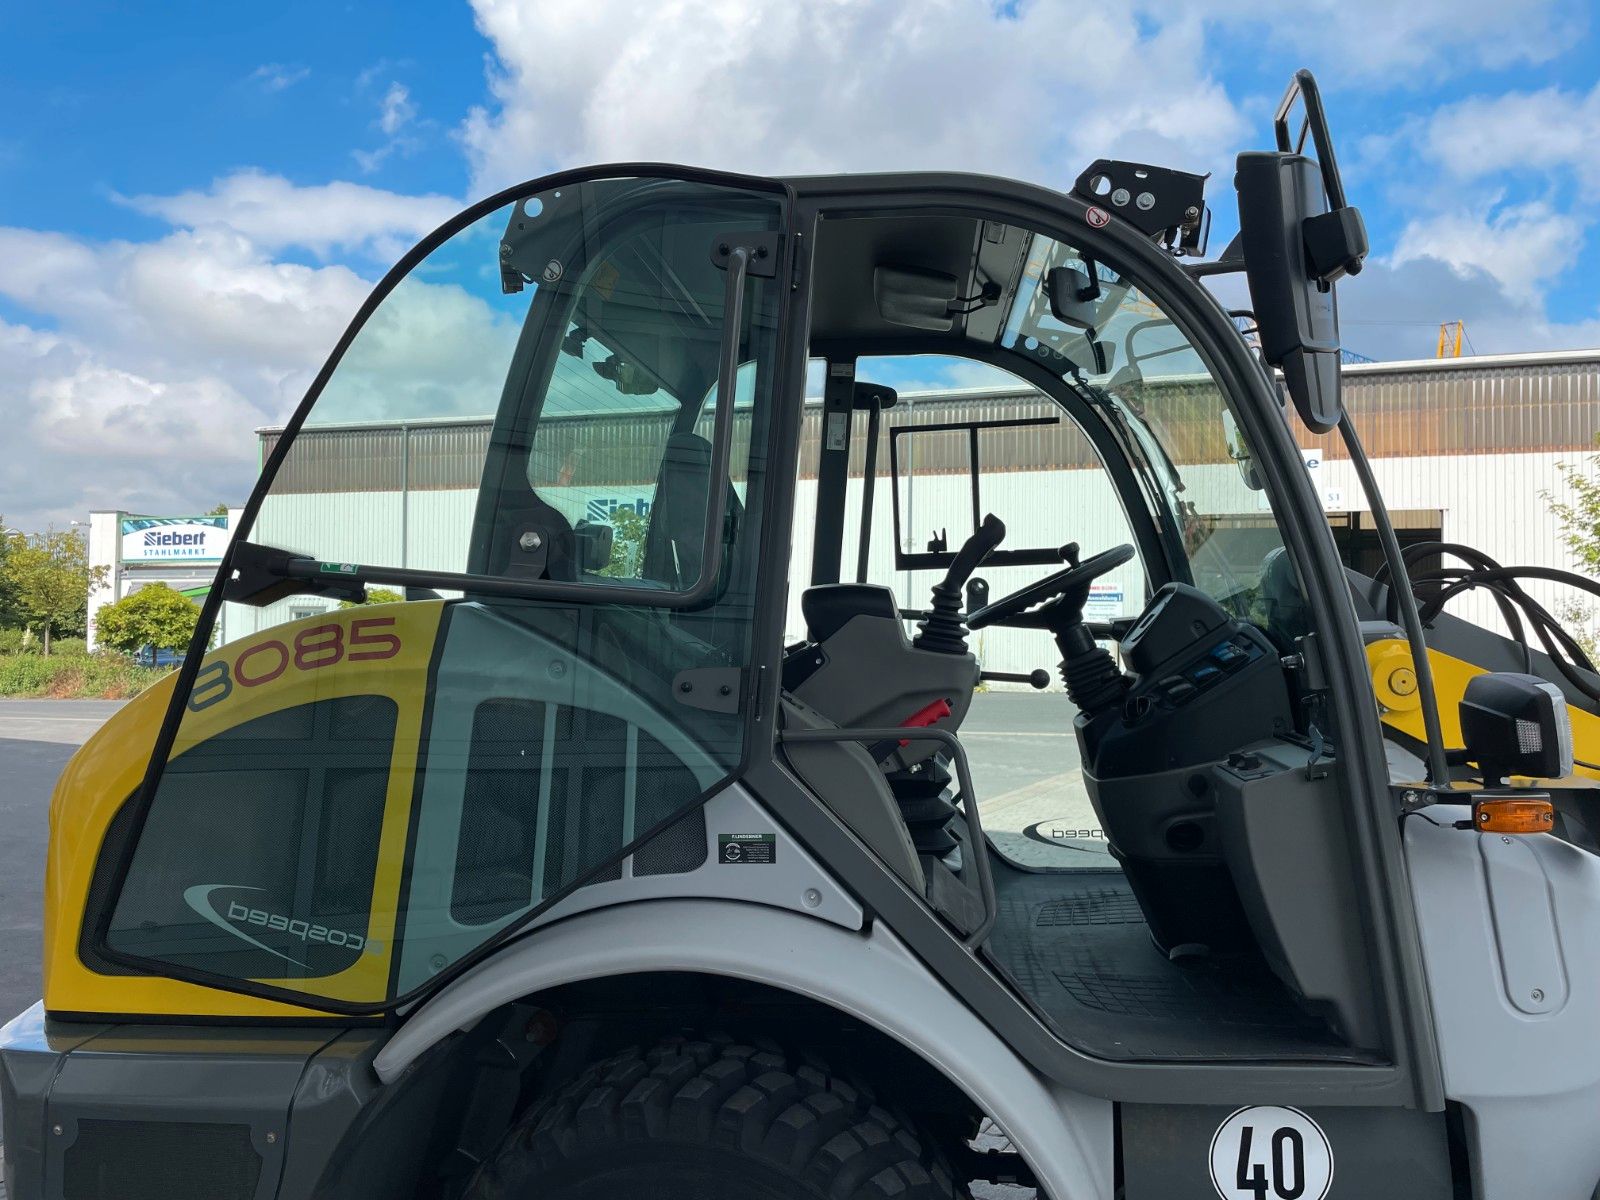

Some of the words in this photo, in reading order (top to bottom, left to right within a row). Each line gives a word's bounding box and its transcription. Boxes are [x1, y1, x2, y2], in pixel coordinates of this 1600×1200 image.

[144, 531, 206, 546] Siebert
[144, 548, 206, 557] STAHLMARKT
[187, 617, 401, 713] 8085
[1237, 1126, 1305, 1200] 40
